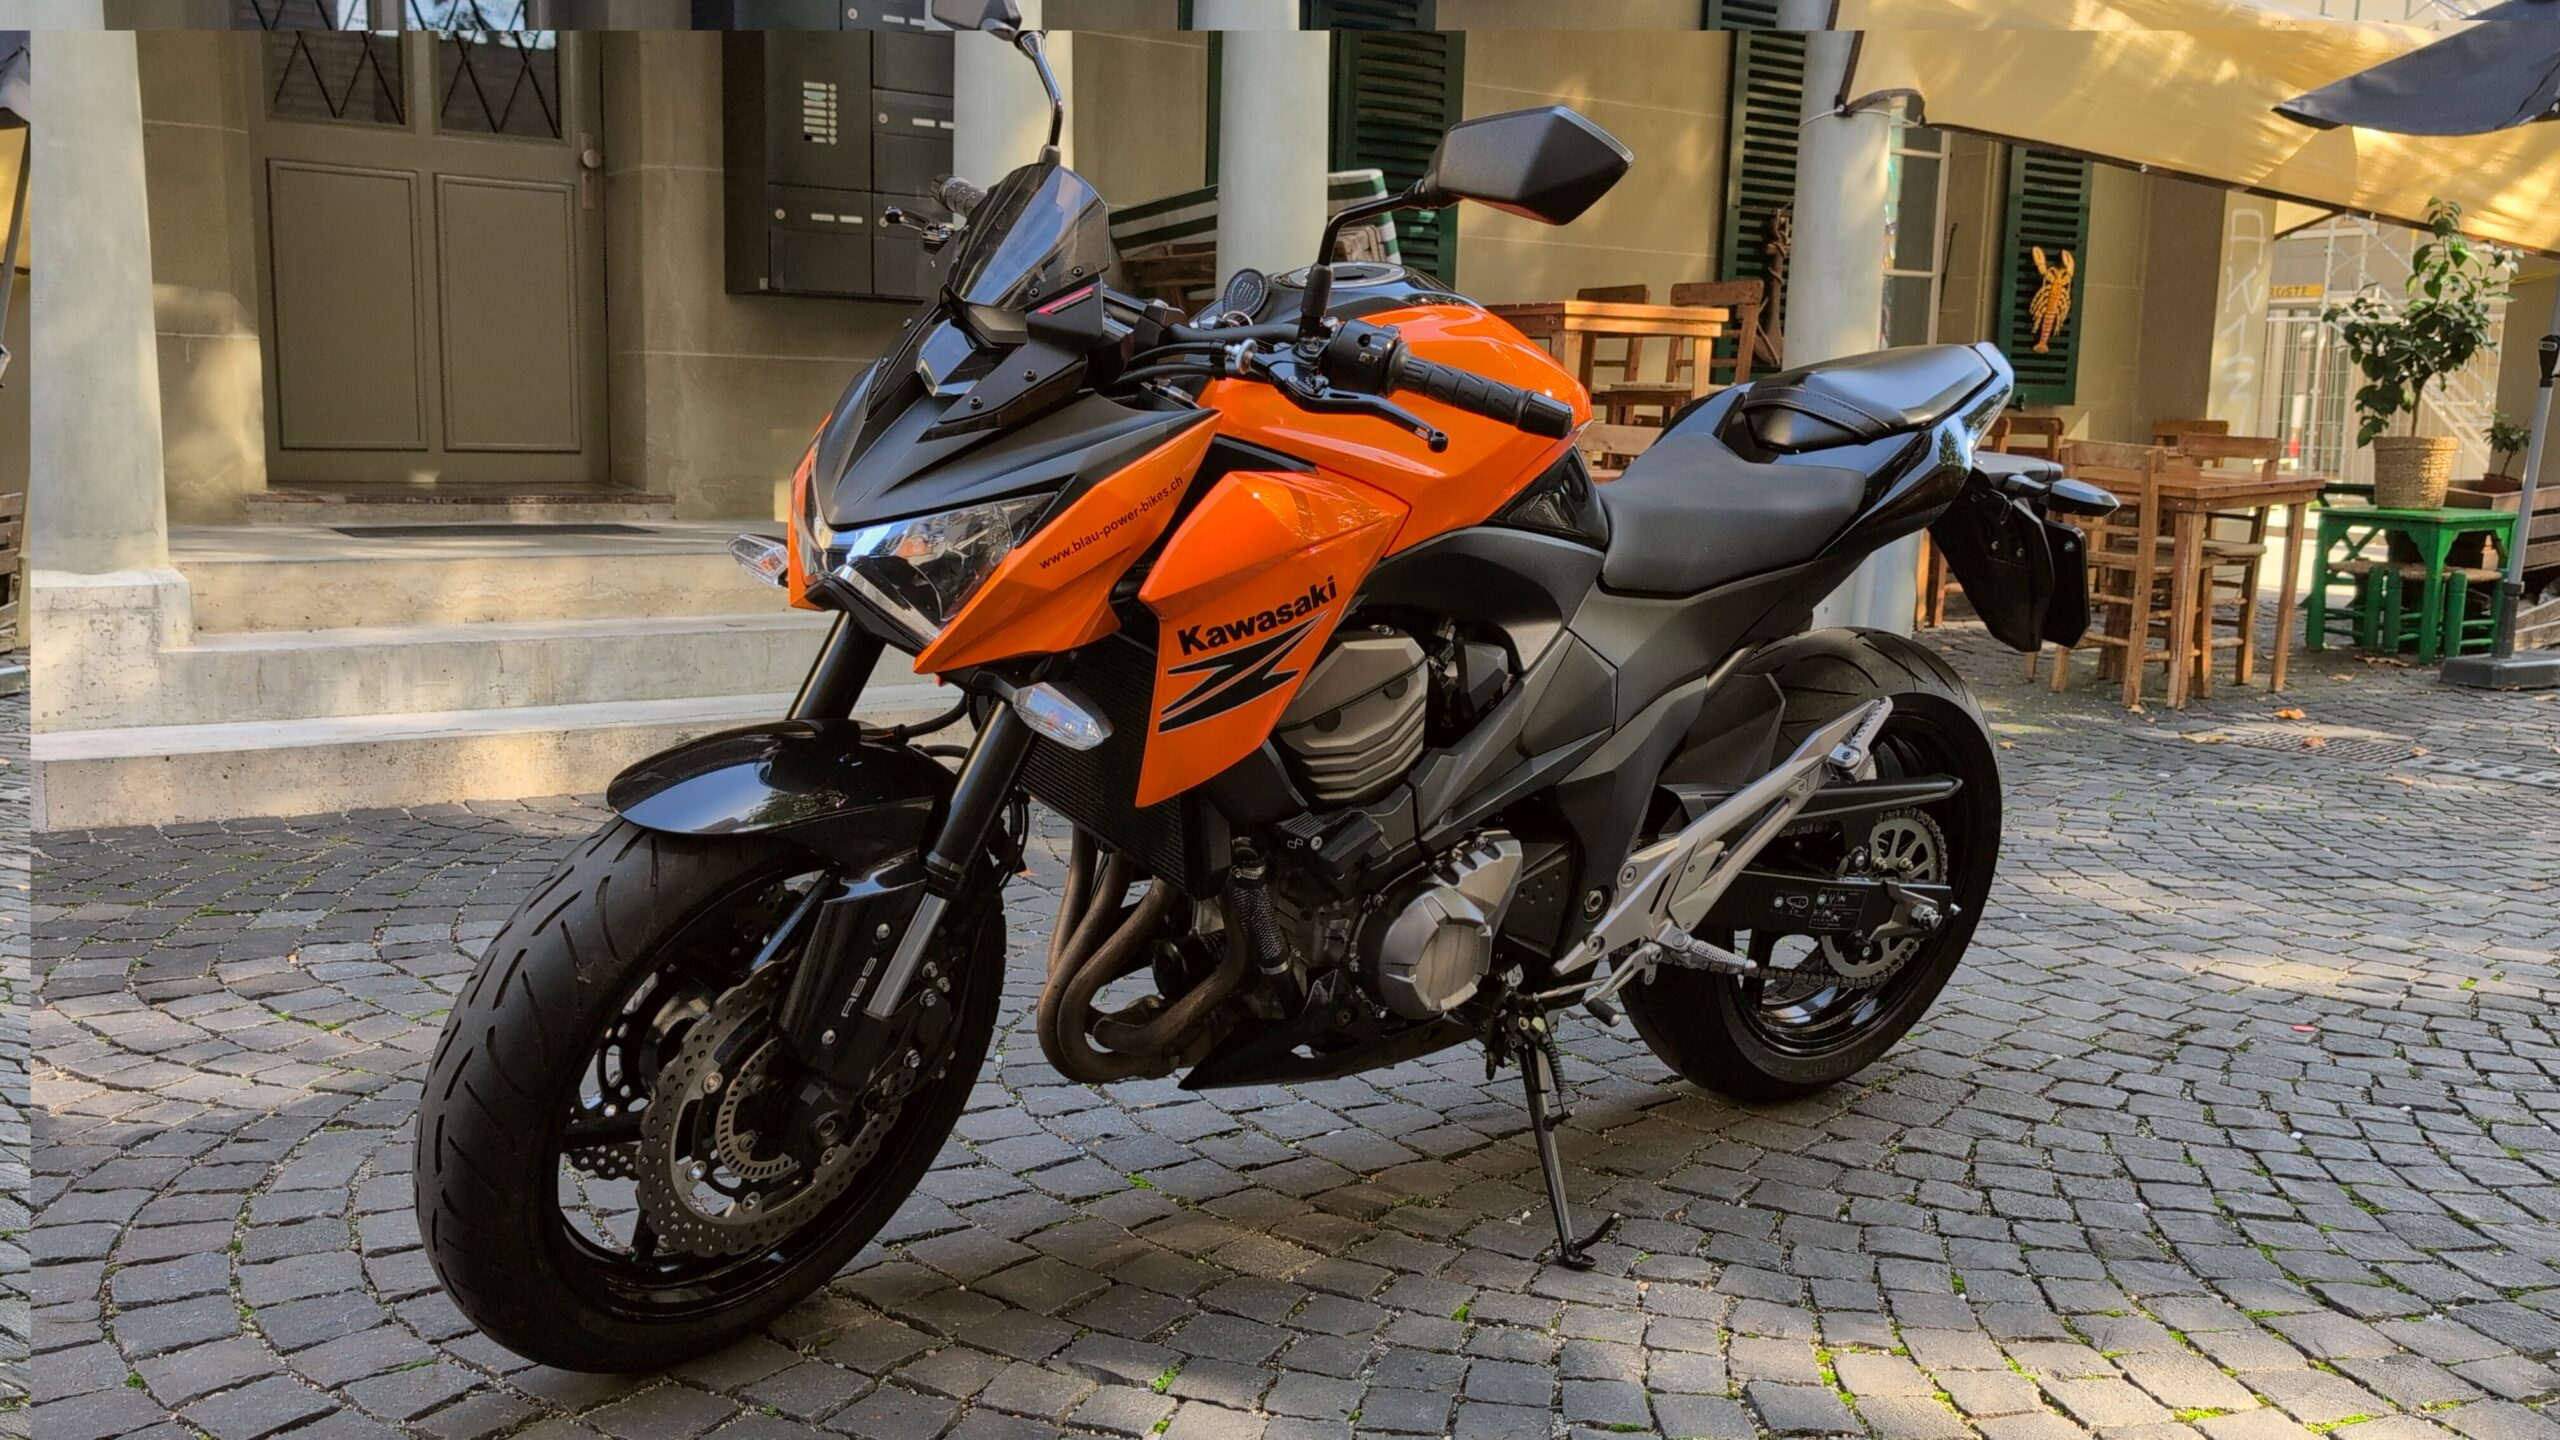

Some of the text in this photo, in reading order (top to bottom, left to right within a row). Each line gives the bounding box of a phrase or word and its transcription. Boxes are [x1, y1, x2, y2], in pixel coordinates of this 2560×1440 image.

[1039, 475, 1183, 569] www.blau-power-bikes.ch
[1177, 575, 1337, 656] Kawasaki
[1158, 608, 1331, 735] Z
[841, 957, 877, 1017] ABS
